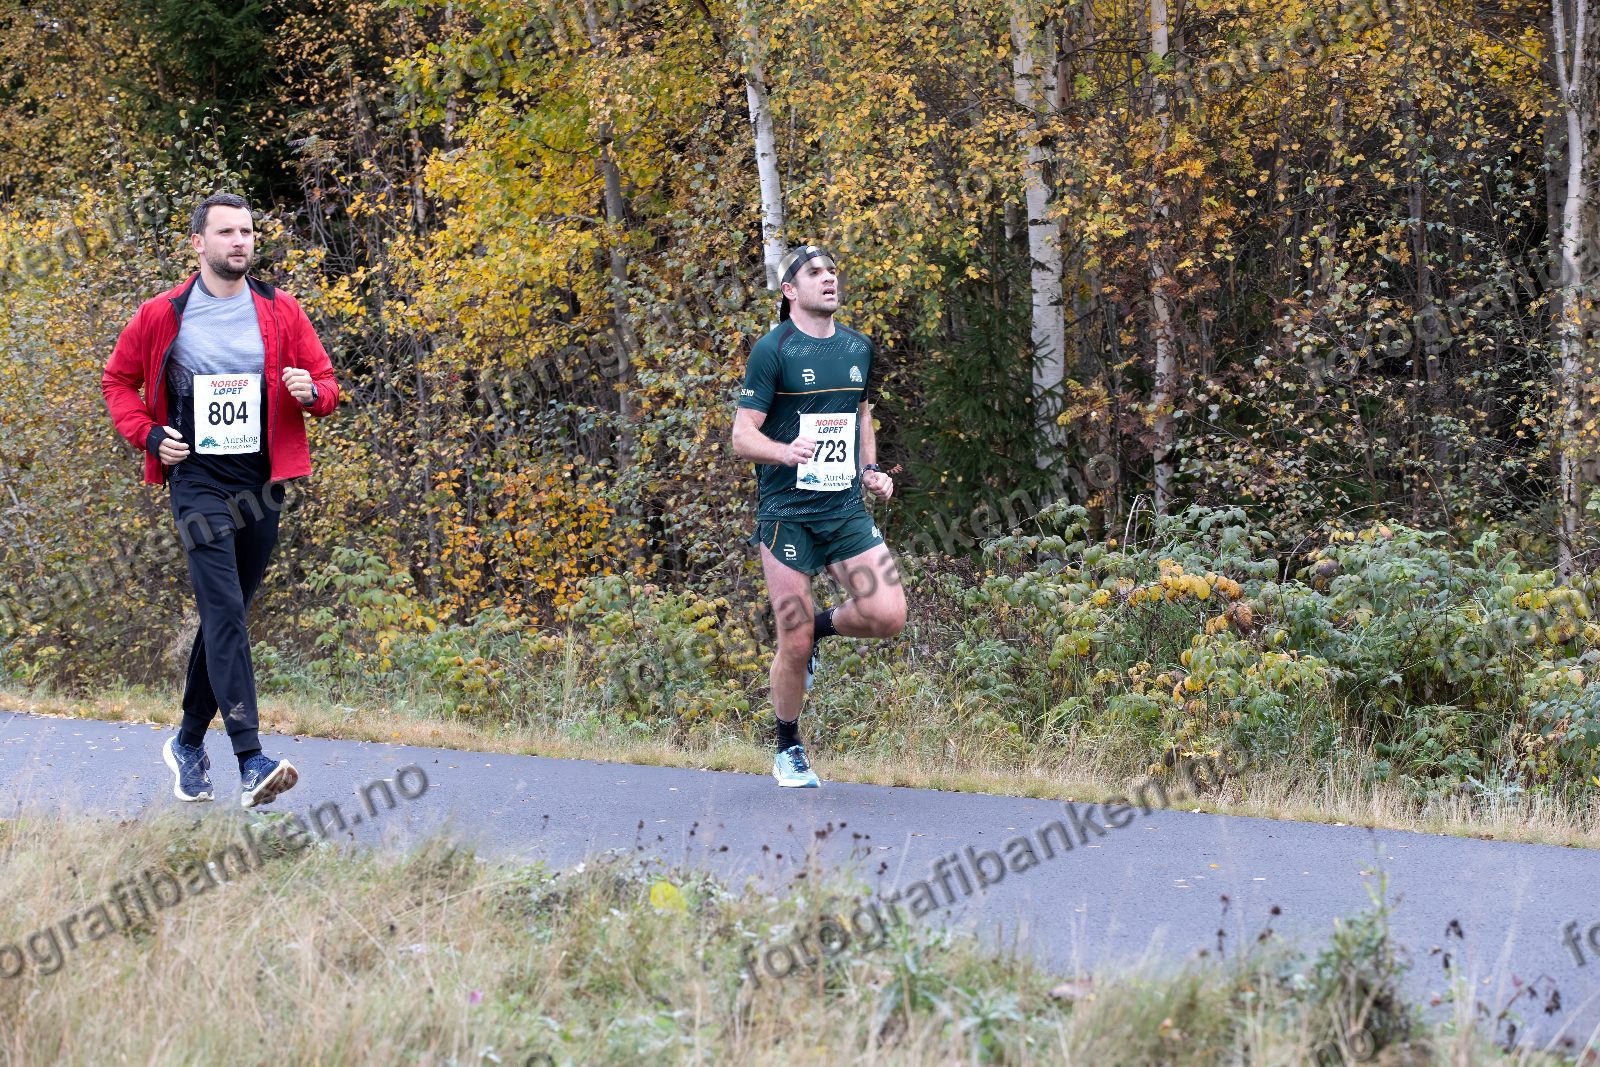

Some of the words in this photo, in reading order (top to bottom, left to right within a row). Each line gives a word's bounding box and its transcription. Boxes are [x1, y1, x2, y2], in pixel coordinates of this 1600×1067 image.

[211, 380, 249, 388] NORGES
[213, 387, 243, 395] LØPET
[208, 401, 249, 426] 804
[815, 419, 848, 427] NORGES
[223, 434, 258, 444] Aurskog
[814, 439, 847, 463] 723
